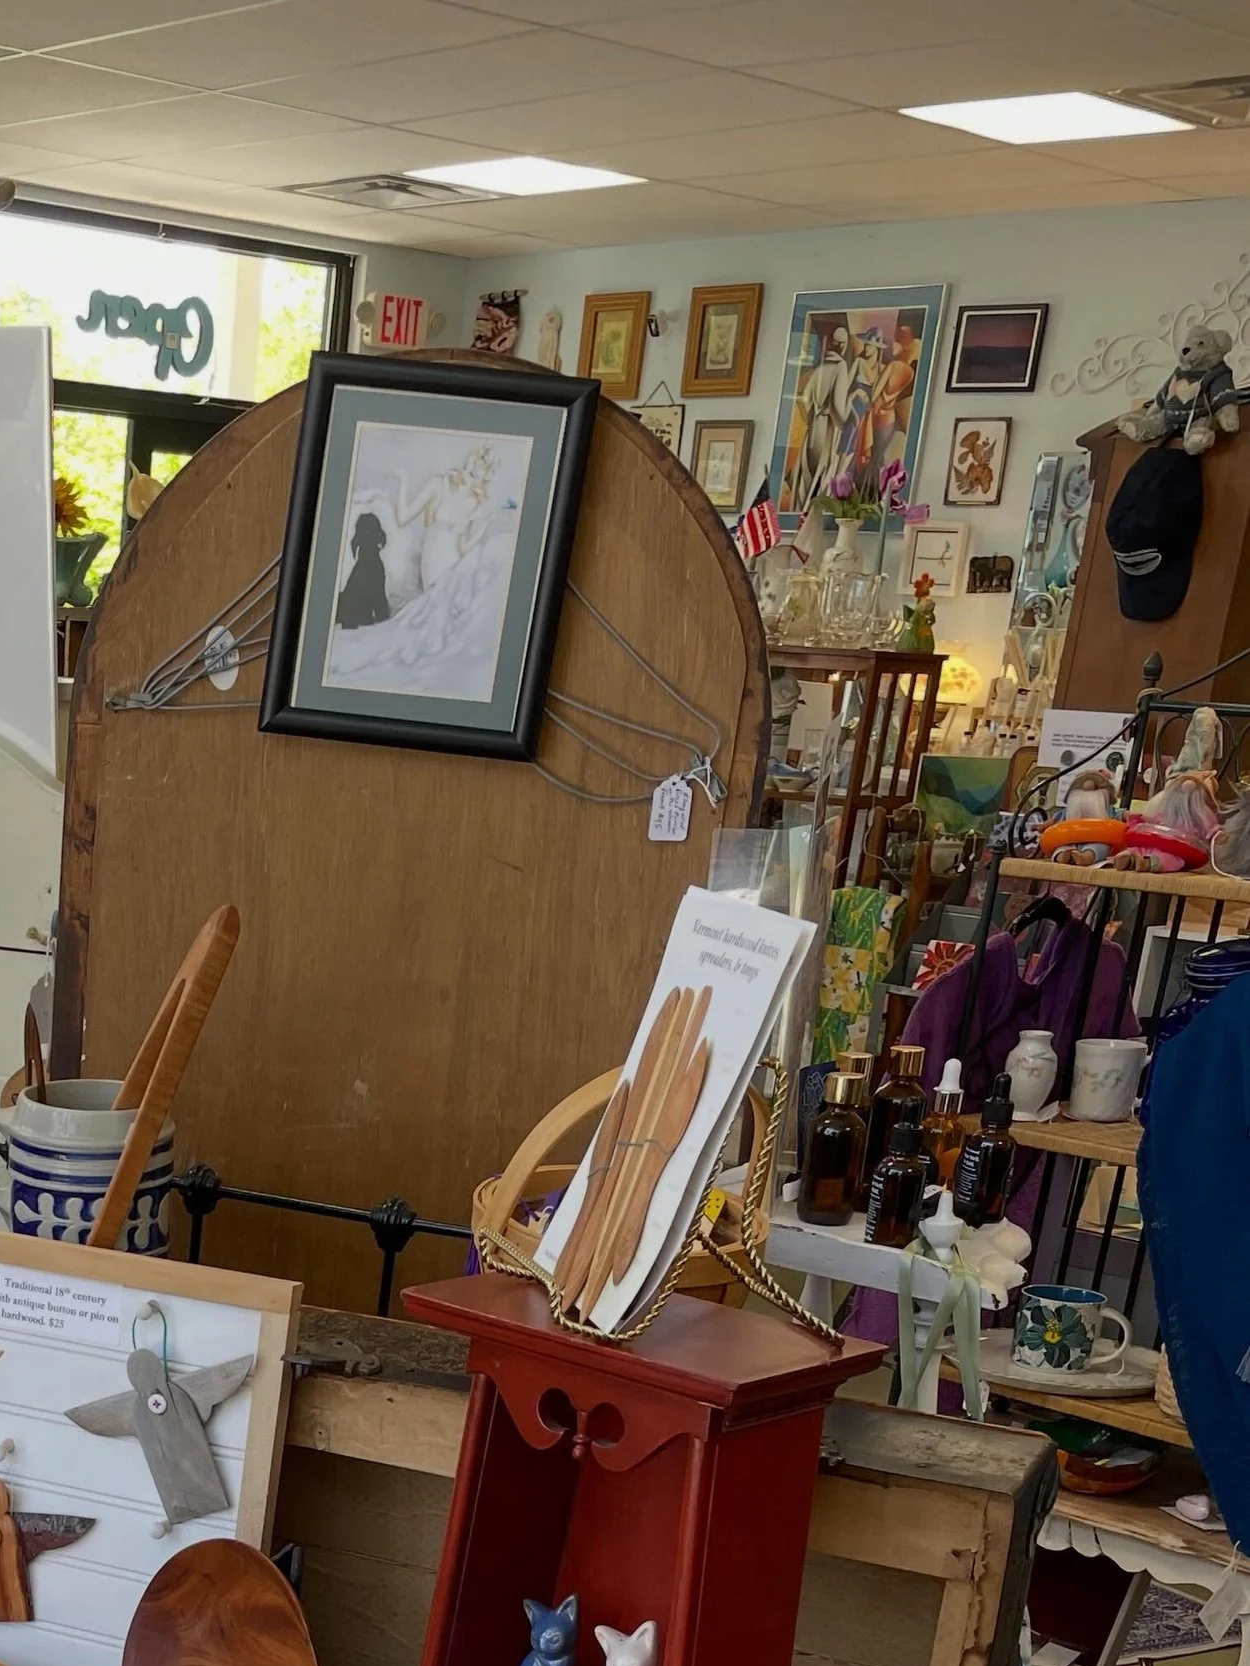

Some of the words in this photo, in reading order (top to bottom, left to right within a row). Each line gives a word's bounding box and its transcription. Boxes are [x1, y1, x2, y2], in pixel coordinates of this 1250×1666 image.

[381, 295, 424, 347] EXIT
[693, 918, 724, 941] Vermont
[722, 928, 761, 953] hardwood
[4, 1277, 53, 1295] Traditional
[72, 1293, 107, 1307] century
[1, 1309, 46, 1326] hardwood.
[49, 1317, 65, 1329] $25
[12, 1298, 45, 1312] antique
[47, 1303, 76, 1316] button
[78, 1310, 89, 1318] or
[90, 1310, 105, 1323] pin
[107, 1315, 119, 1324] on
